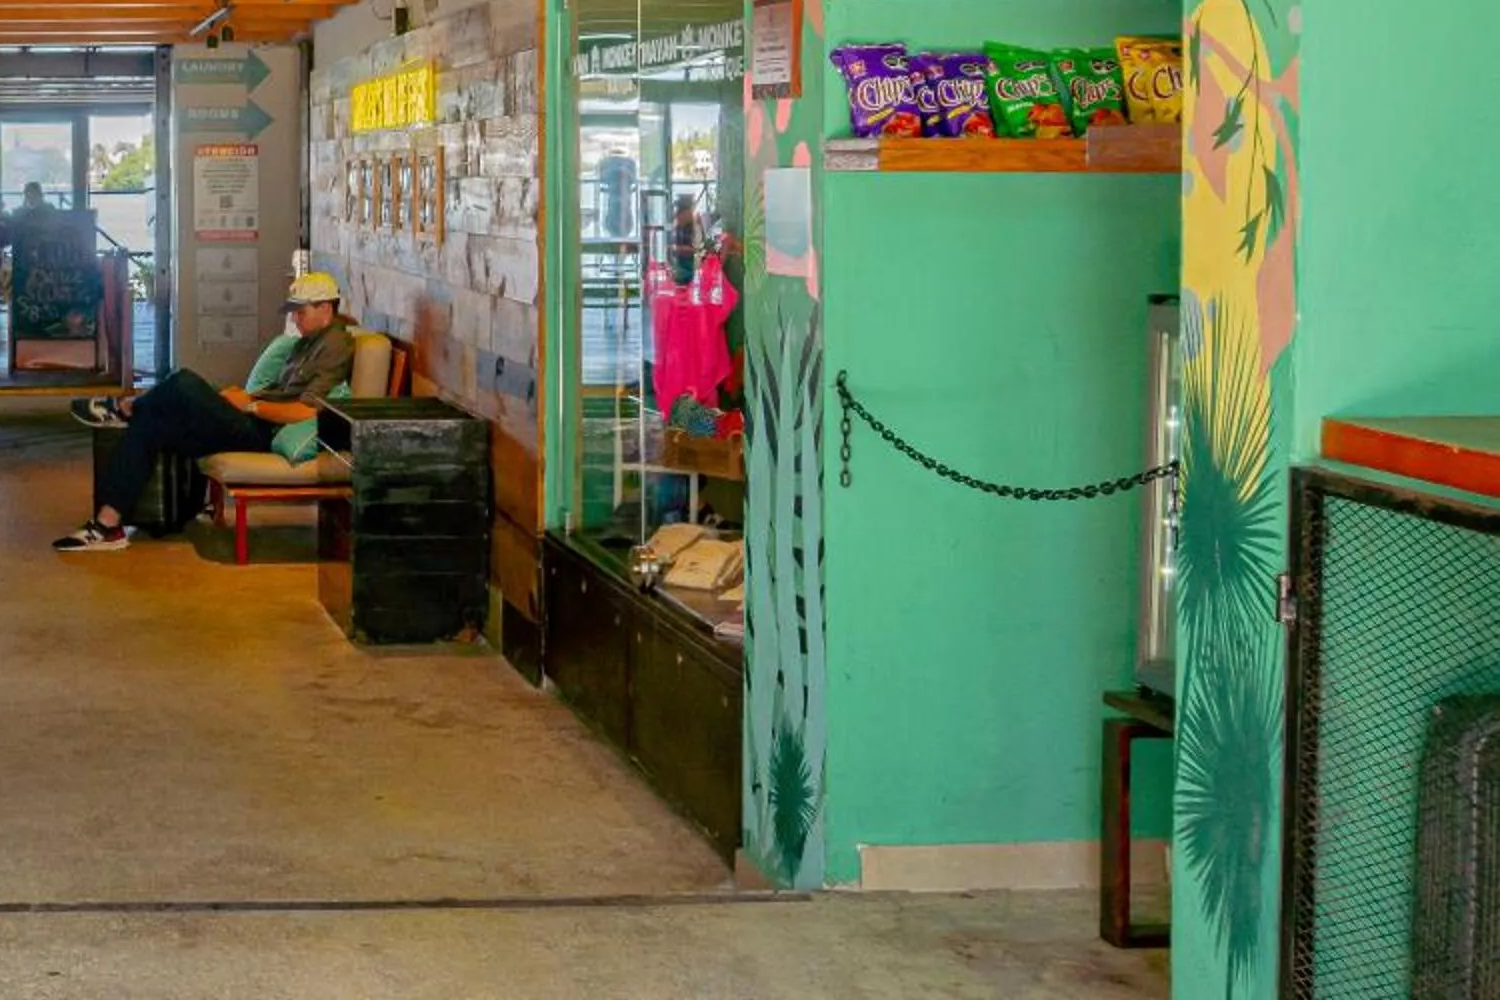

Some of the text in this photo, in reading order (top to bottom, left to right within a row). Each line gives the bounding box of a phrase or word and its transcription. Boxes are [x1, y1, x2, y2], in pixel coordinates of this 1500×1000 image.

[698, 19, 743, 50] MONKE
[180, 62, 245, 74] LAUNDRY
[187, 109, 240, 120] ROOMS
